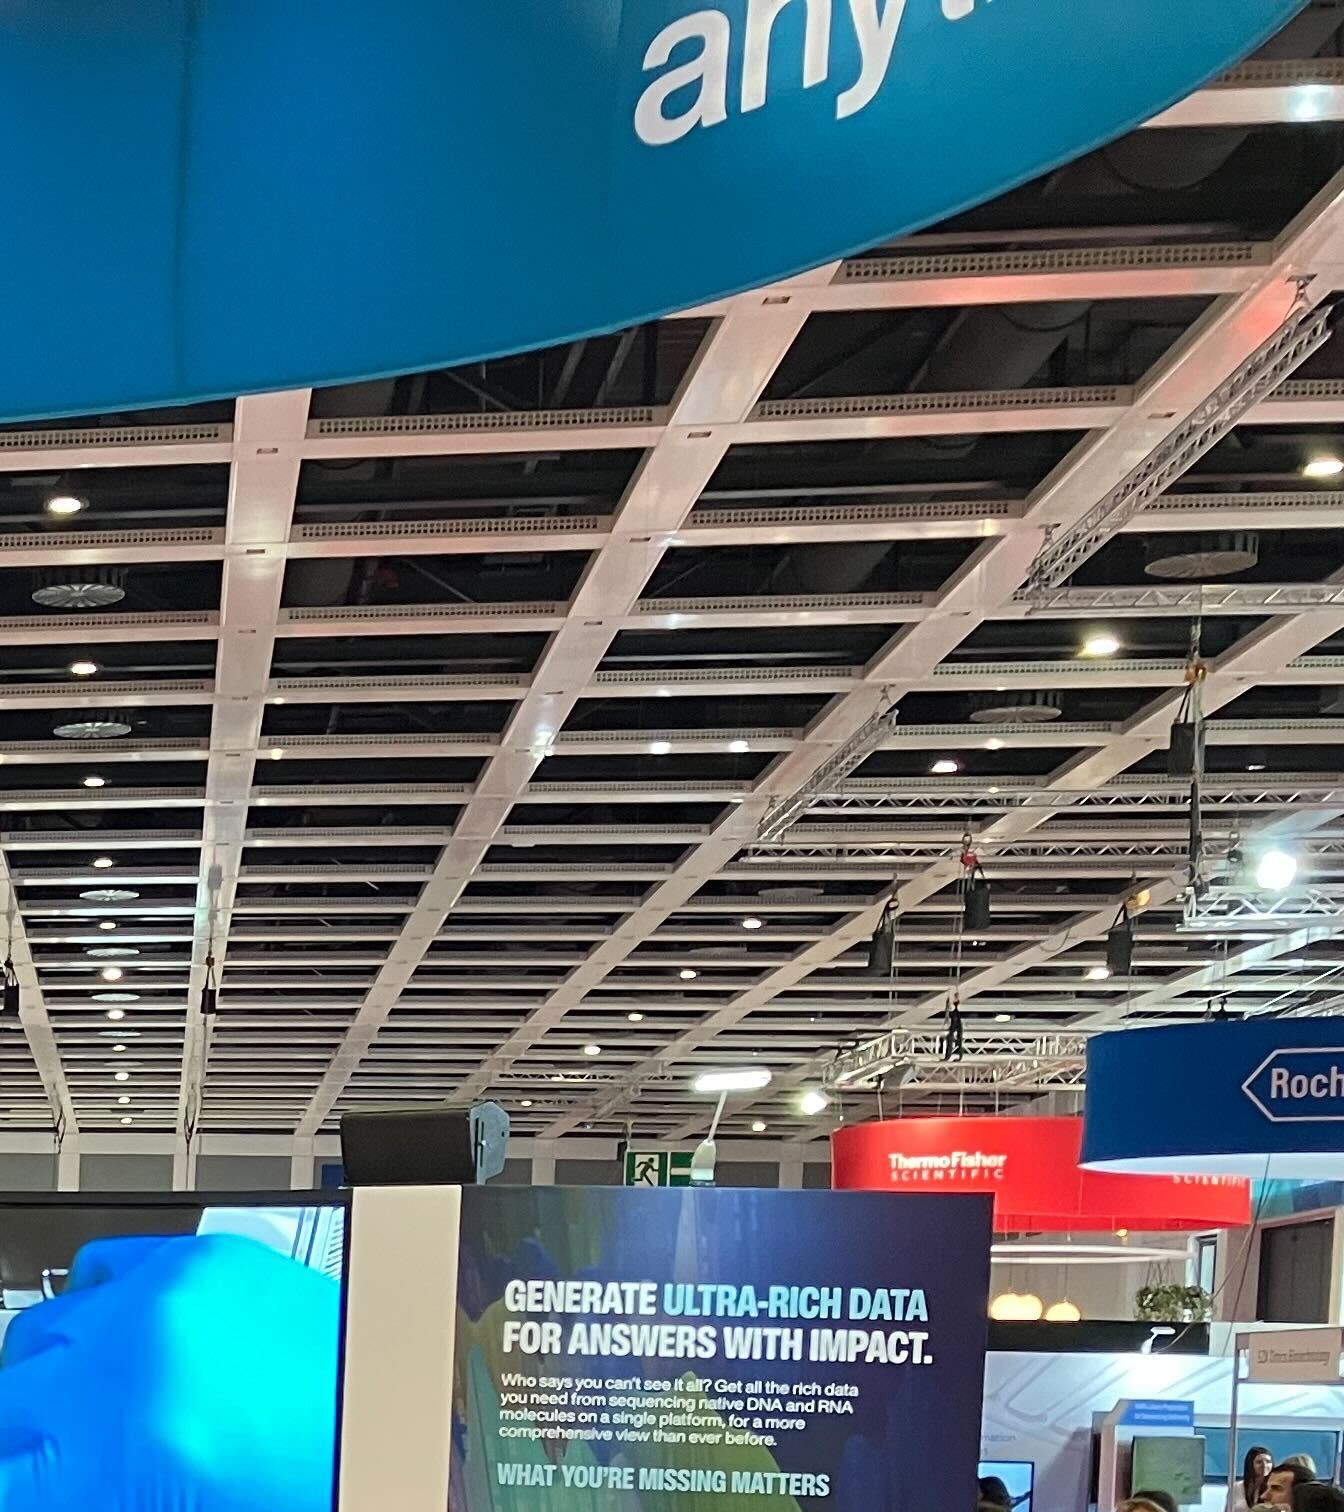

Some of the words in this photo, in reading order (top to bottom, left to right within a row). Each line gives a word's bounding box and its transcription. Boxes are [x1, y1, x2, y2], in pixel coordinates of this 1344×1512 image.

[1271, 1065, 1344, 1099] Roch
[891, 1168, 1004, 1181] SCIENTIFIC
[504, 1279, 658, 1315] GENERATE
[663, 1284, 842, 1320] ULTRA-RICH
[848, 1287, 929, 1322] DATA
[502, 1321, 562, 1355] FOR
[567, 1323, 717, 1359] ANSWERS
[722, 1326, 804, 1361] WITH
[810, 1328, 934, 1365] IMPACT.
[501, 1373, 537, 1388] Who
[538, 1377, 573, 1392] says
[575, 1379, 603, 1393] you
[605, 1376, 642, 1391] can't
[643, 1381, 672, 1392] see
[673, 1377, 684, 1391] it
[685, 1378, 712, 1393] all?
[714, 1379, 742, 1394] Get
[745, 1380, 763, 1395] all
[765, 1380, 790, 1395] the
[792, 1382, 821, 1396] rich
[824, 1382, 859, 1397] data
[500, 1394, 528, 1408] you
[530, 1391, 569, 1406] need
[571, 1392, 607, 1407] from
[608, 1394, 696, 1412] sequencing
[698, 1397, 744, 1411] native
[747, 1398, 783, 1412] DNA
[785, 1399, 814, 1413] and
[817, 1400, 854, 1415] RNA
[499, 1408, 576, 1424] molecules
[578, 1412, 598, 1423] on
[599, 1413, 610, 1424] a
[611, 1411, 656, 1428] single
[659, 1412, 726, 1429] platform,
[728, 1414, 750, 1428] for
[752, 1418, 763, 1429] a
[765, 1418, 806, 1430] more
[499, 1427, 613, 1442] comprehensive
[615, 1428, 650, 1441] view
[653, 1428, 687, 1443] than
[689, 1433, 723, 1444] ever
[725, 1432, 777, 1447] before.
[497, 1462, 556, 1487] WHAT
[562, 1465, 635, 1490] YOU'RE
[638, 1467, 726, 1493] MISSING
[731, 1471, 830, 1497] MATTERS
